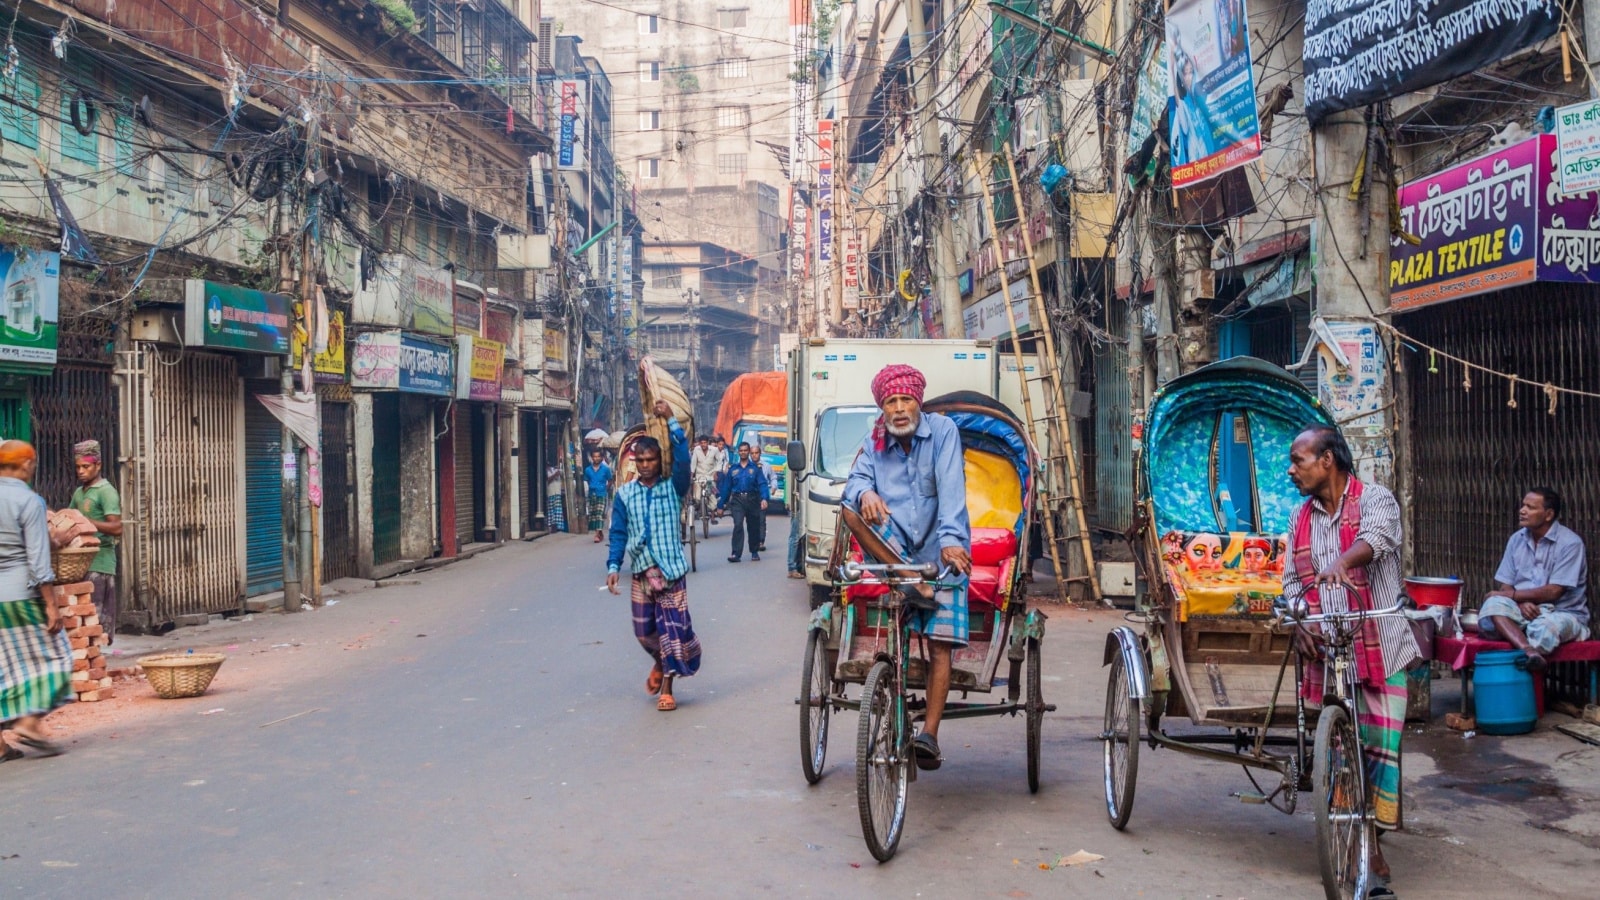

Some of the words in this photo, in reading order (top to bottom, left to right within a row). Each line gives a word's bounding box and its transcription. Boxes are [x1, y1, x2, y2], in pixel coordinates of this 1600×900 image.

[1562, 112, 1581, 127] ডাঃ
[1418, 158, 1534, 239] টেক্সটাইল
[1390, 250, 1434, 288] PLAZA
[1438, 228, 1506, 276] TEXTILE
